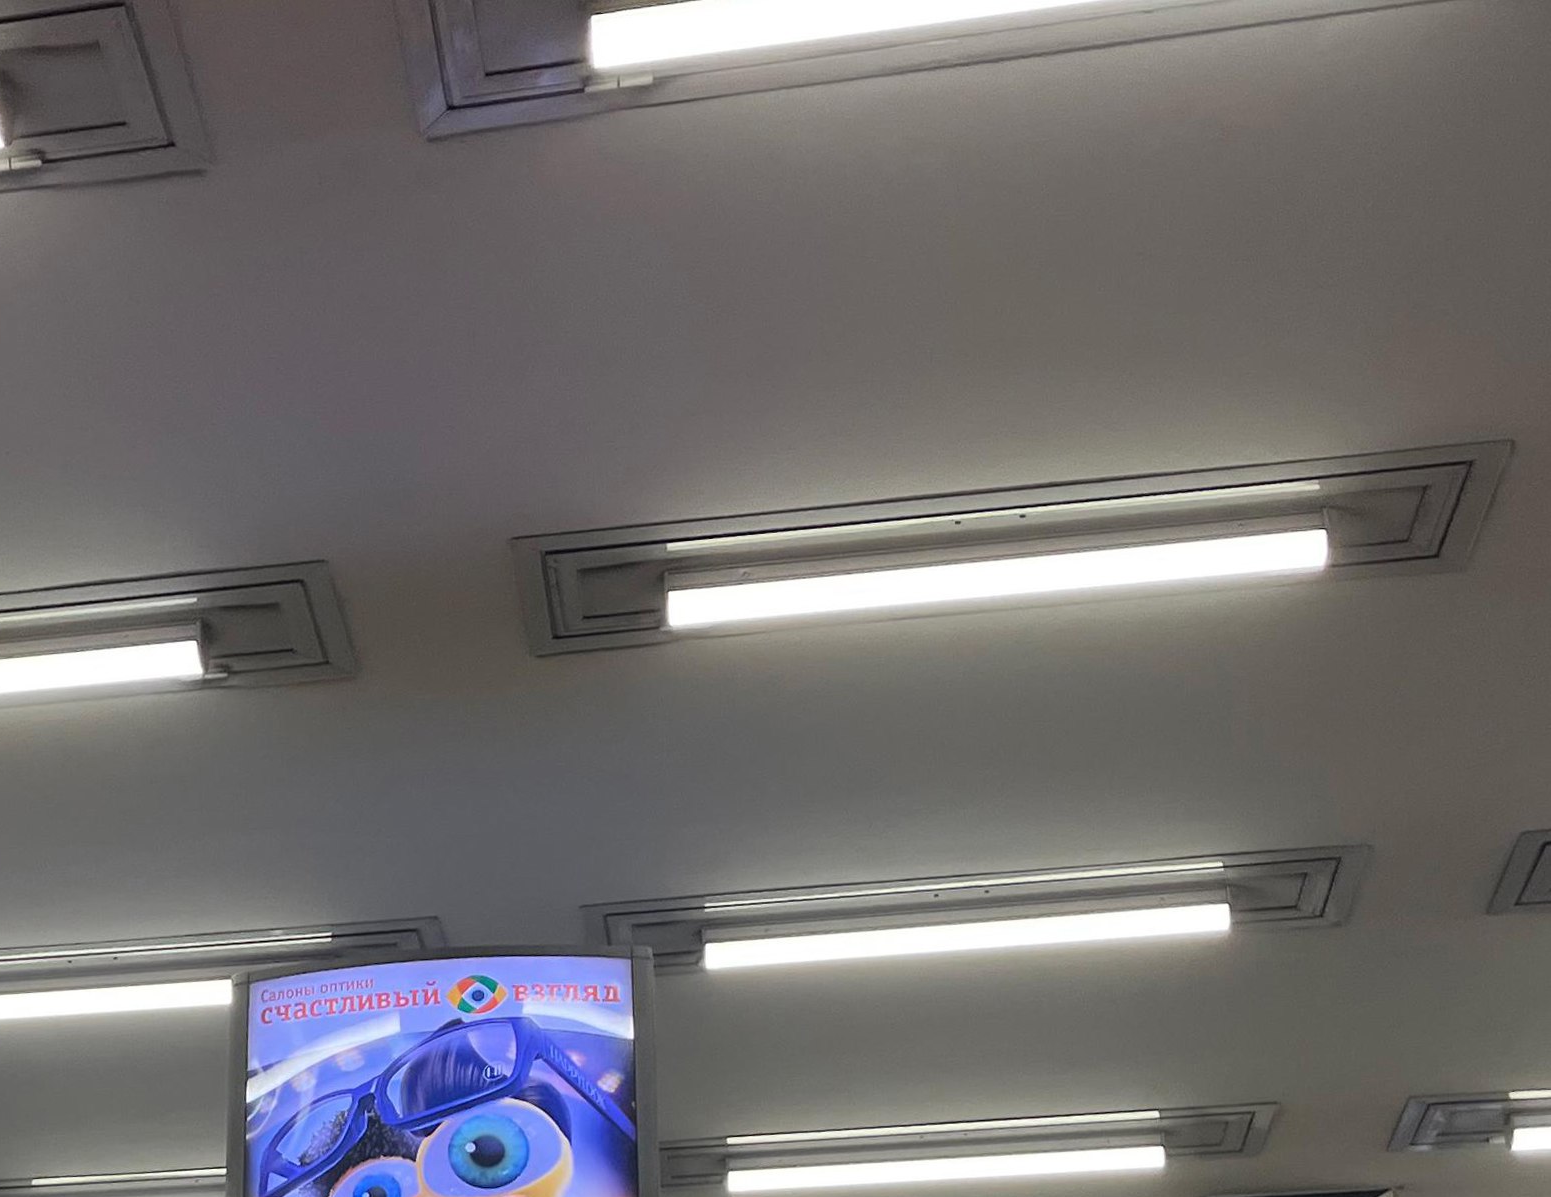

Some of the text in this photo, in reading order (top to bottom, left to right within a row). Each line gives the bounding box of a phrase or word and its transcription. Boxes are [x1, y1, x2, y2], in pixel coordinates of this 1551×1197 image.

[260, 978, 374, 1003] Салоны оптики
[260, 980, 621, 1025] счастливый взгляд
